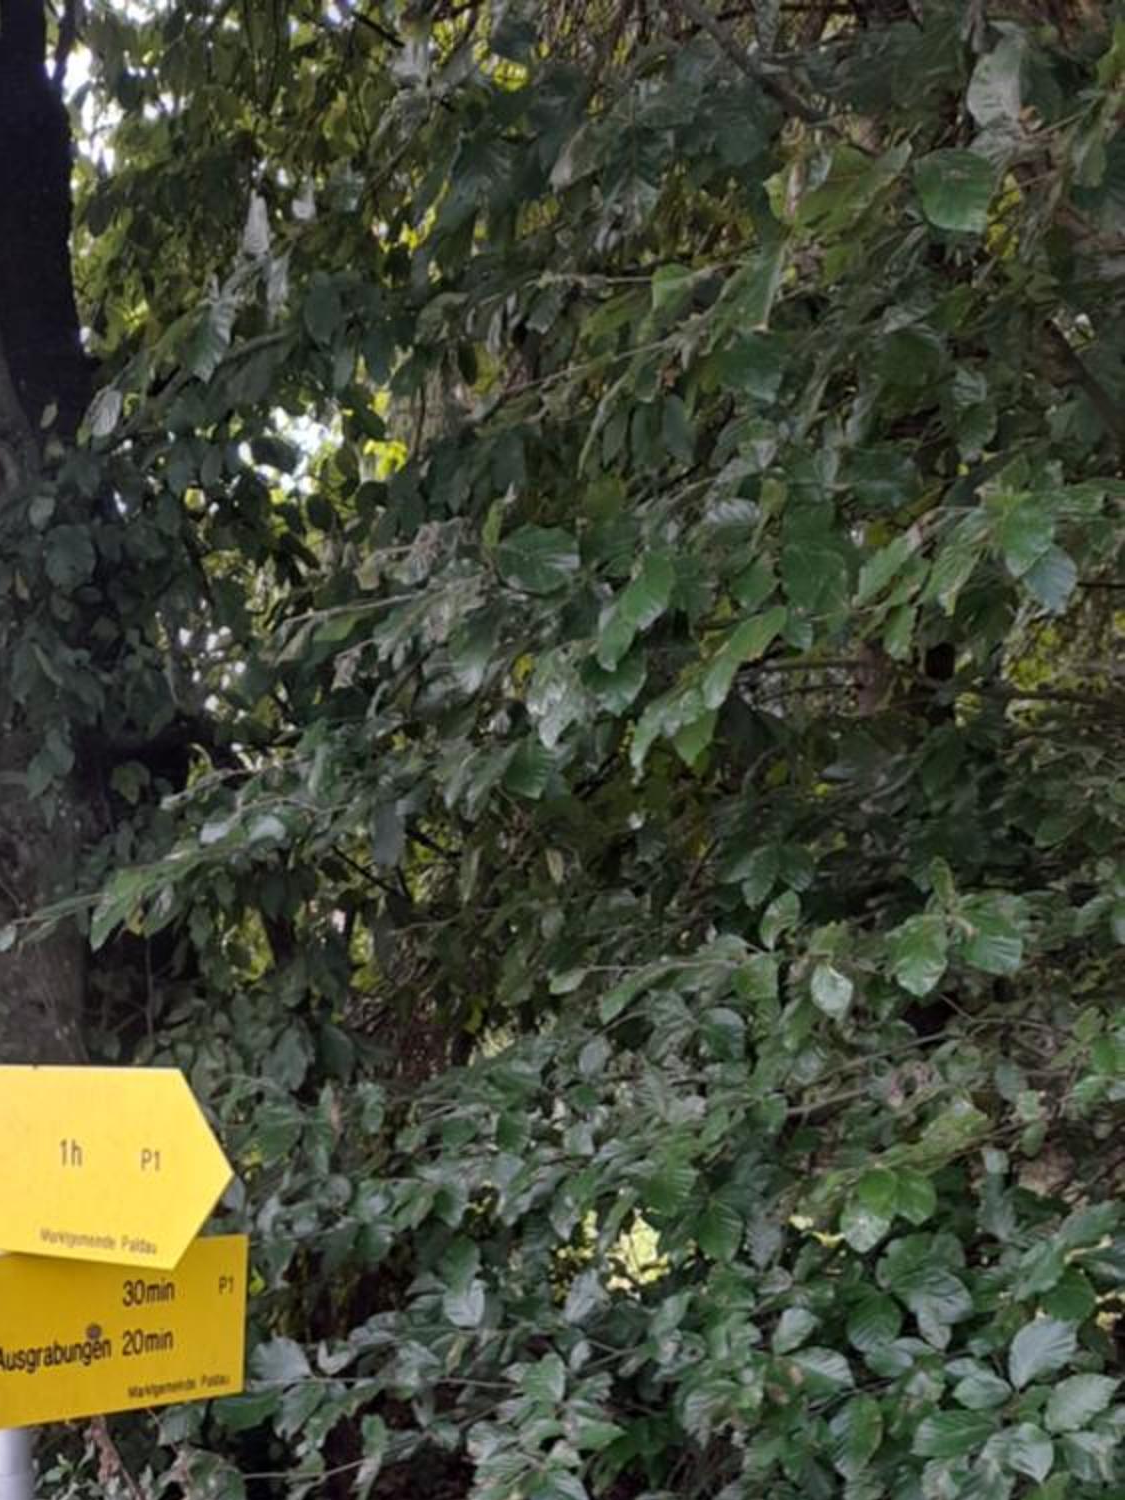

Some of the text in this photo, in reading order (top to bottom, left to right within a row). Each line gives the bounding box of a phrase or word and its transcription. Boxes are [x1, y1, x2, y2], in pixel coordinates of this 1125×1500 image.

[59, 1139, 83, 1167] 1h
[140, 1148, 162, 1172] P1
[121, 1234, 158, 1255] Paldau
[122, 1278, 175, 1307] 30min
[218, 1277, 234, 1294] P1
[121, 1329, 174, 1356] 20min
